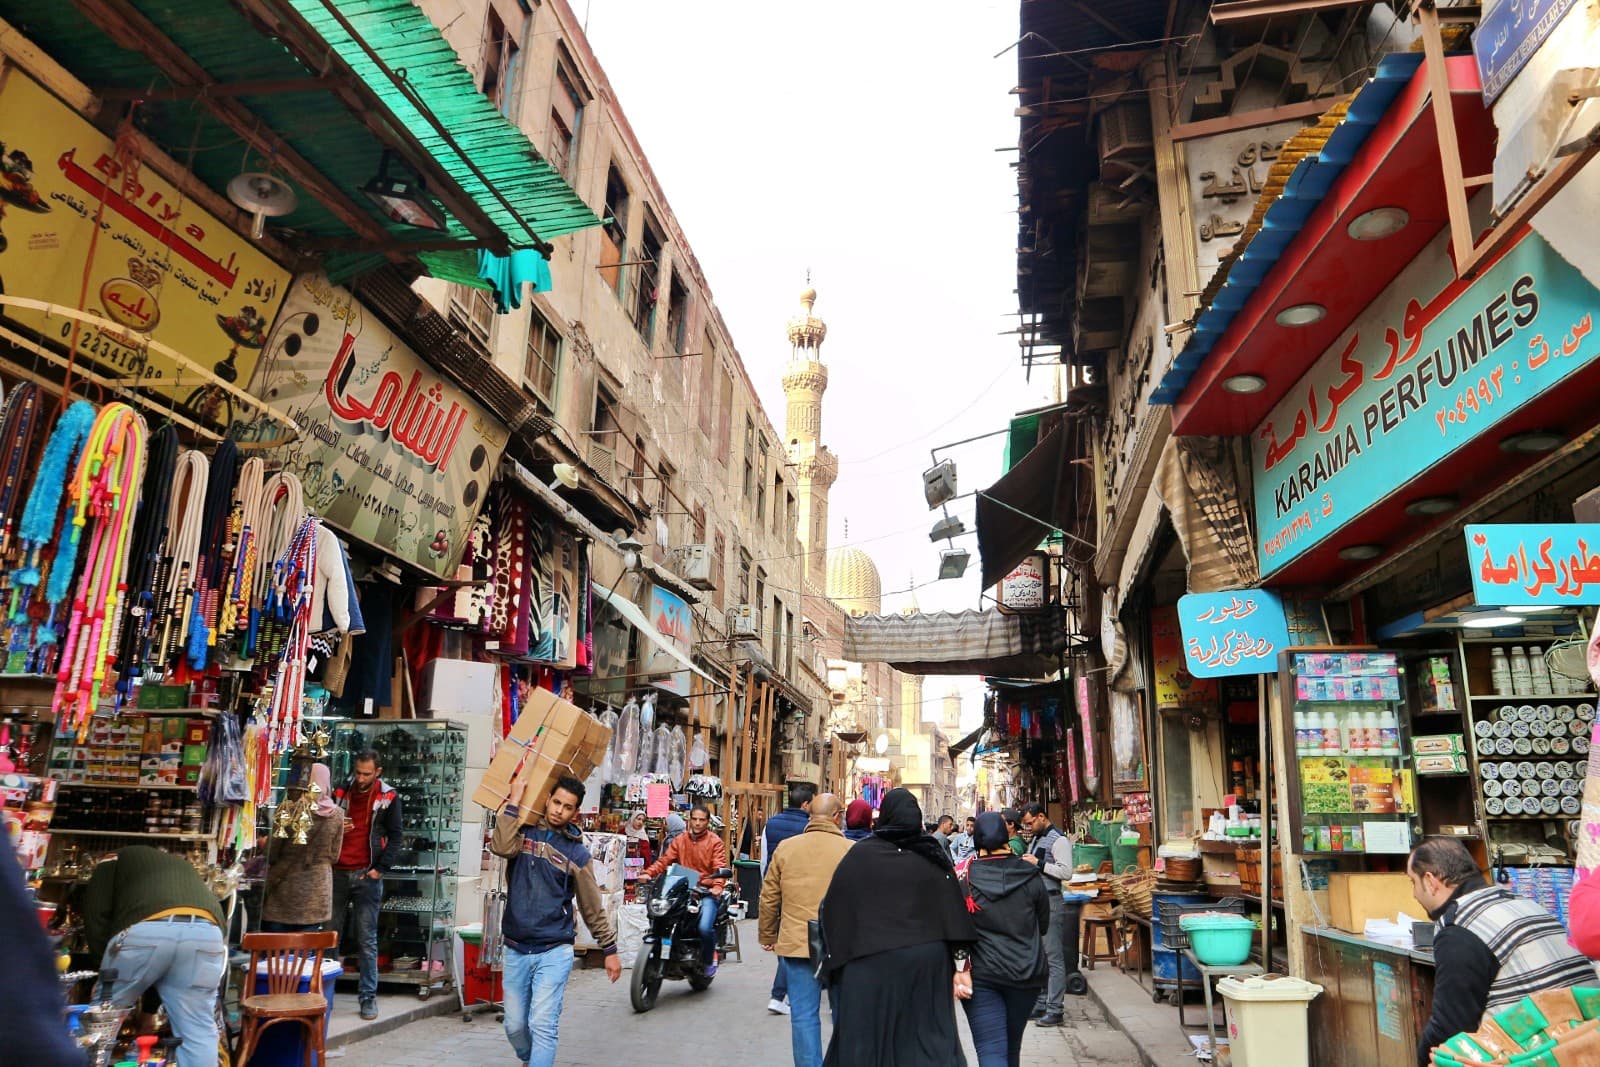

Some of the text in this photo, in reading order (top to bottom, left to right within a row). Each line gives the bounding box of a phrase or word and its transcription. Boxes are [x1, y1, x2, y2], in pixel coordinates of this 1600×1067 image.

[1274, 274, 1540, 519] KARAMA PERFUMES
[373, 458, 393, 481] شنط
[1195, 596, 1259, 624] عطور
